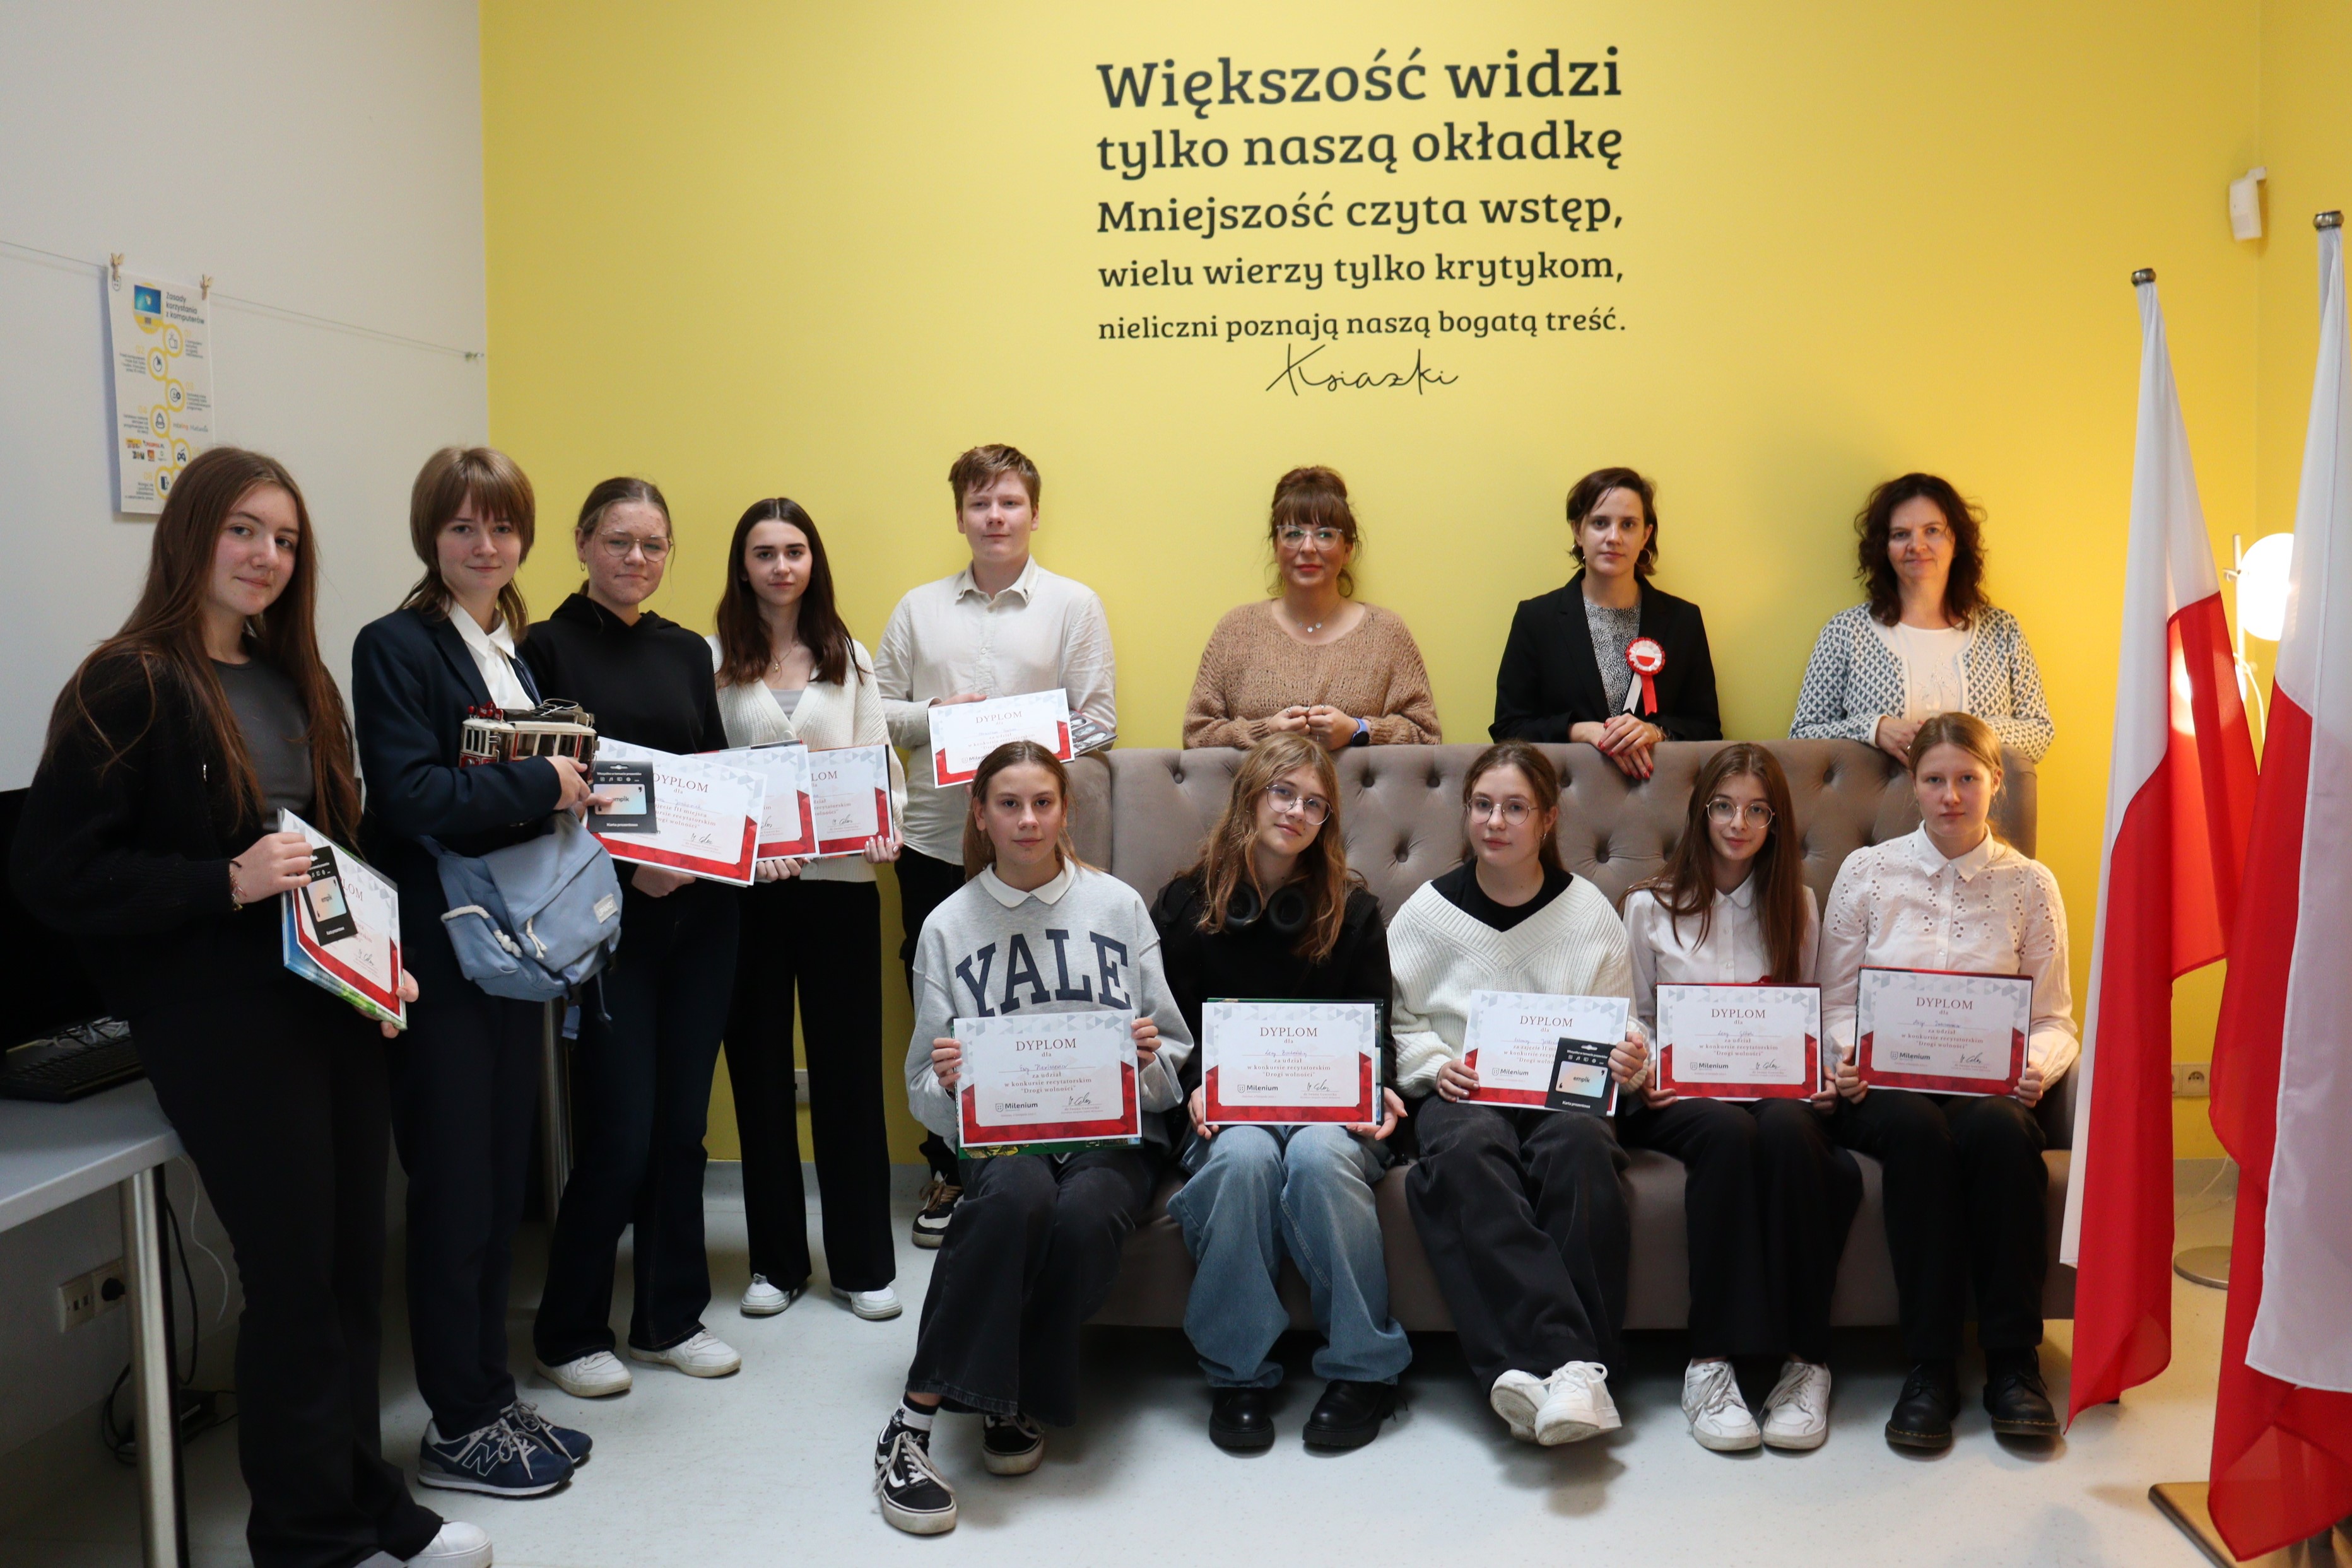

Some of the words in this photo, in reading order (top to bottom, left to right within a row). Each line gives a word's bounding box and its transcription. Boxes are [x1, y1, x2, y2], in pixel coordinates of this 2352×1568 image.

[1095, 46, 1426, 120] Większość
[1444, 45, 1622, 99] widzi
[1096, 129, 1228, 181] tylko
[1244, 133, 1397, 174] naszą
[1412, 119, 1622, 170] okładkę
[1097, 190, 1334, 240] Mniejszość
[1346, 196, 1467, 235] czyta
[1479, 194, 1623, 233] wstęp,
[1097, 259, 1194, 288] wielu
[1202, 257, 1323, 291] wierzy
[1334, 254, 1425, 290] tylko
[1435, 251, 1623, 288] krytykom,
[167, 292, 186, 303] Zasady
[167, 301, 197, 314] korzystania
[170, 312, 204, 324] komputerów
[1098, 315, 1218, 340] nieliczni
[1225, 312, 1339, 343] poznają
[1346, 316, 1431, 338] naszą
[1438, 310, 1538, 339] bogatą
[1545, 306, 1626, 331] treść.
[975, 710, 1022, 723] DYPLOM
[811, 771, 838, 781] LOM
[673, 814, 716, 826] recytatorskim
[955, 928, 1132, 1017] YALE
[1917, 997, 1973, 1010] DYPLOM
[1712, 1009, 1766, 1019] DYPLOM
[1520, 1015, 1573, 1027] DYPLOM
[1260, 1027, 1317, 1037] DYPLOM
[1016, 1038, 1076, 1051] DYPLOM
[1012, 1079, 1044, 1087] konkursie
